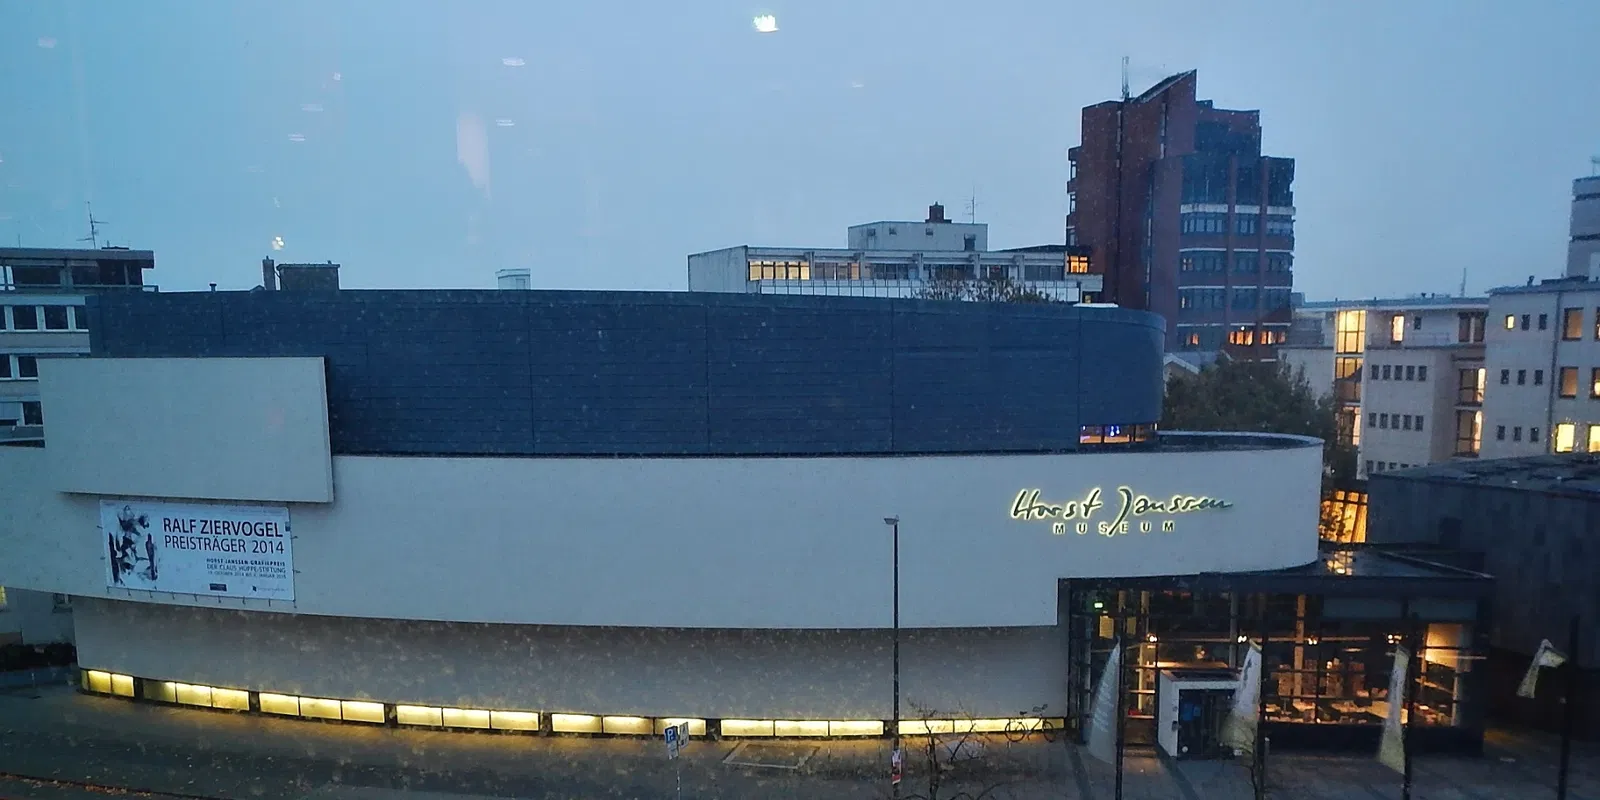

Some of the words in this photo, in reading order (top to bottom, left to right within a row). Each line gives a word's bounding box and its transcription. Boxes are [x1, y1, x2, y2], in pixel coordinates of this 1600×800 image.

[1011, 489, 1102, 519] Horst
[1108, 487, 1234, 536] Janssen
[163, 517, 196, 533] RALF
[200, 519, 283, 537] ZIERVOGEL
[1053, 521, 1176, 534] MUSEUM
[164, 535, 246, 553] PREISTRÄGER
[252, 539, 284, 554] 2014
